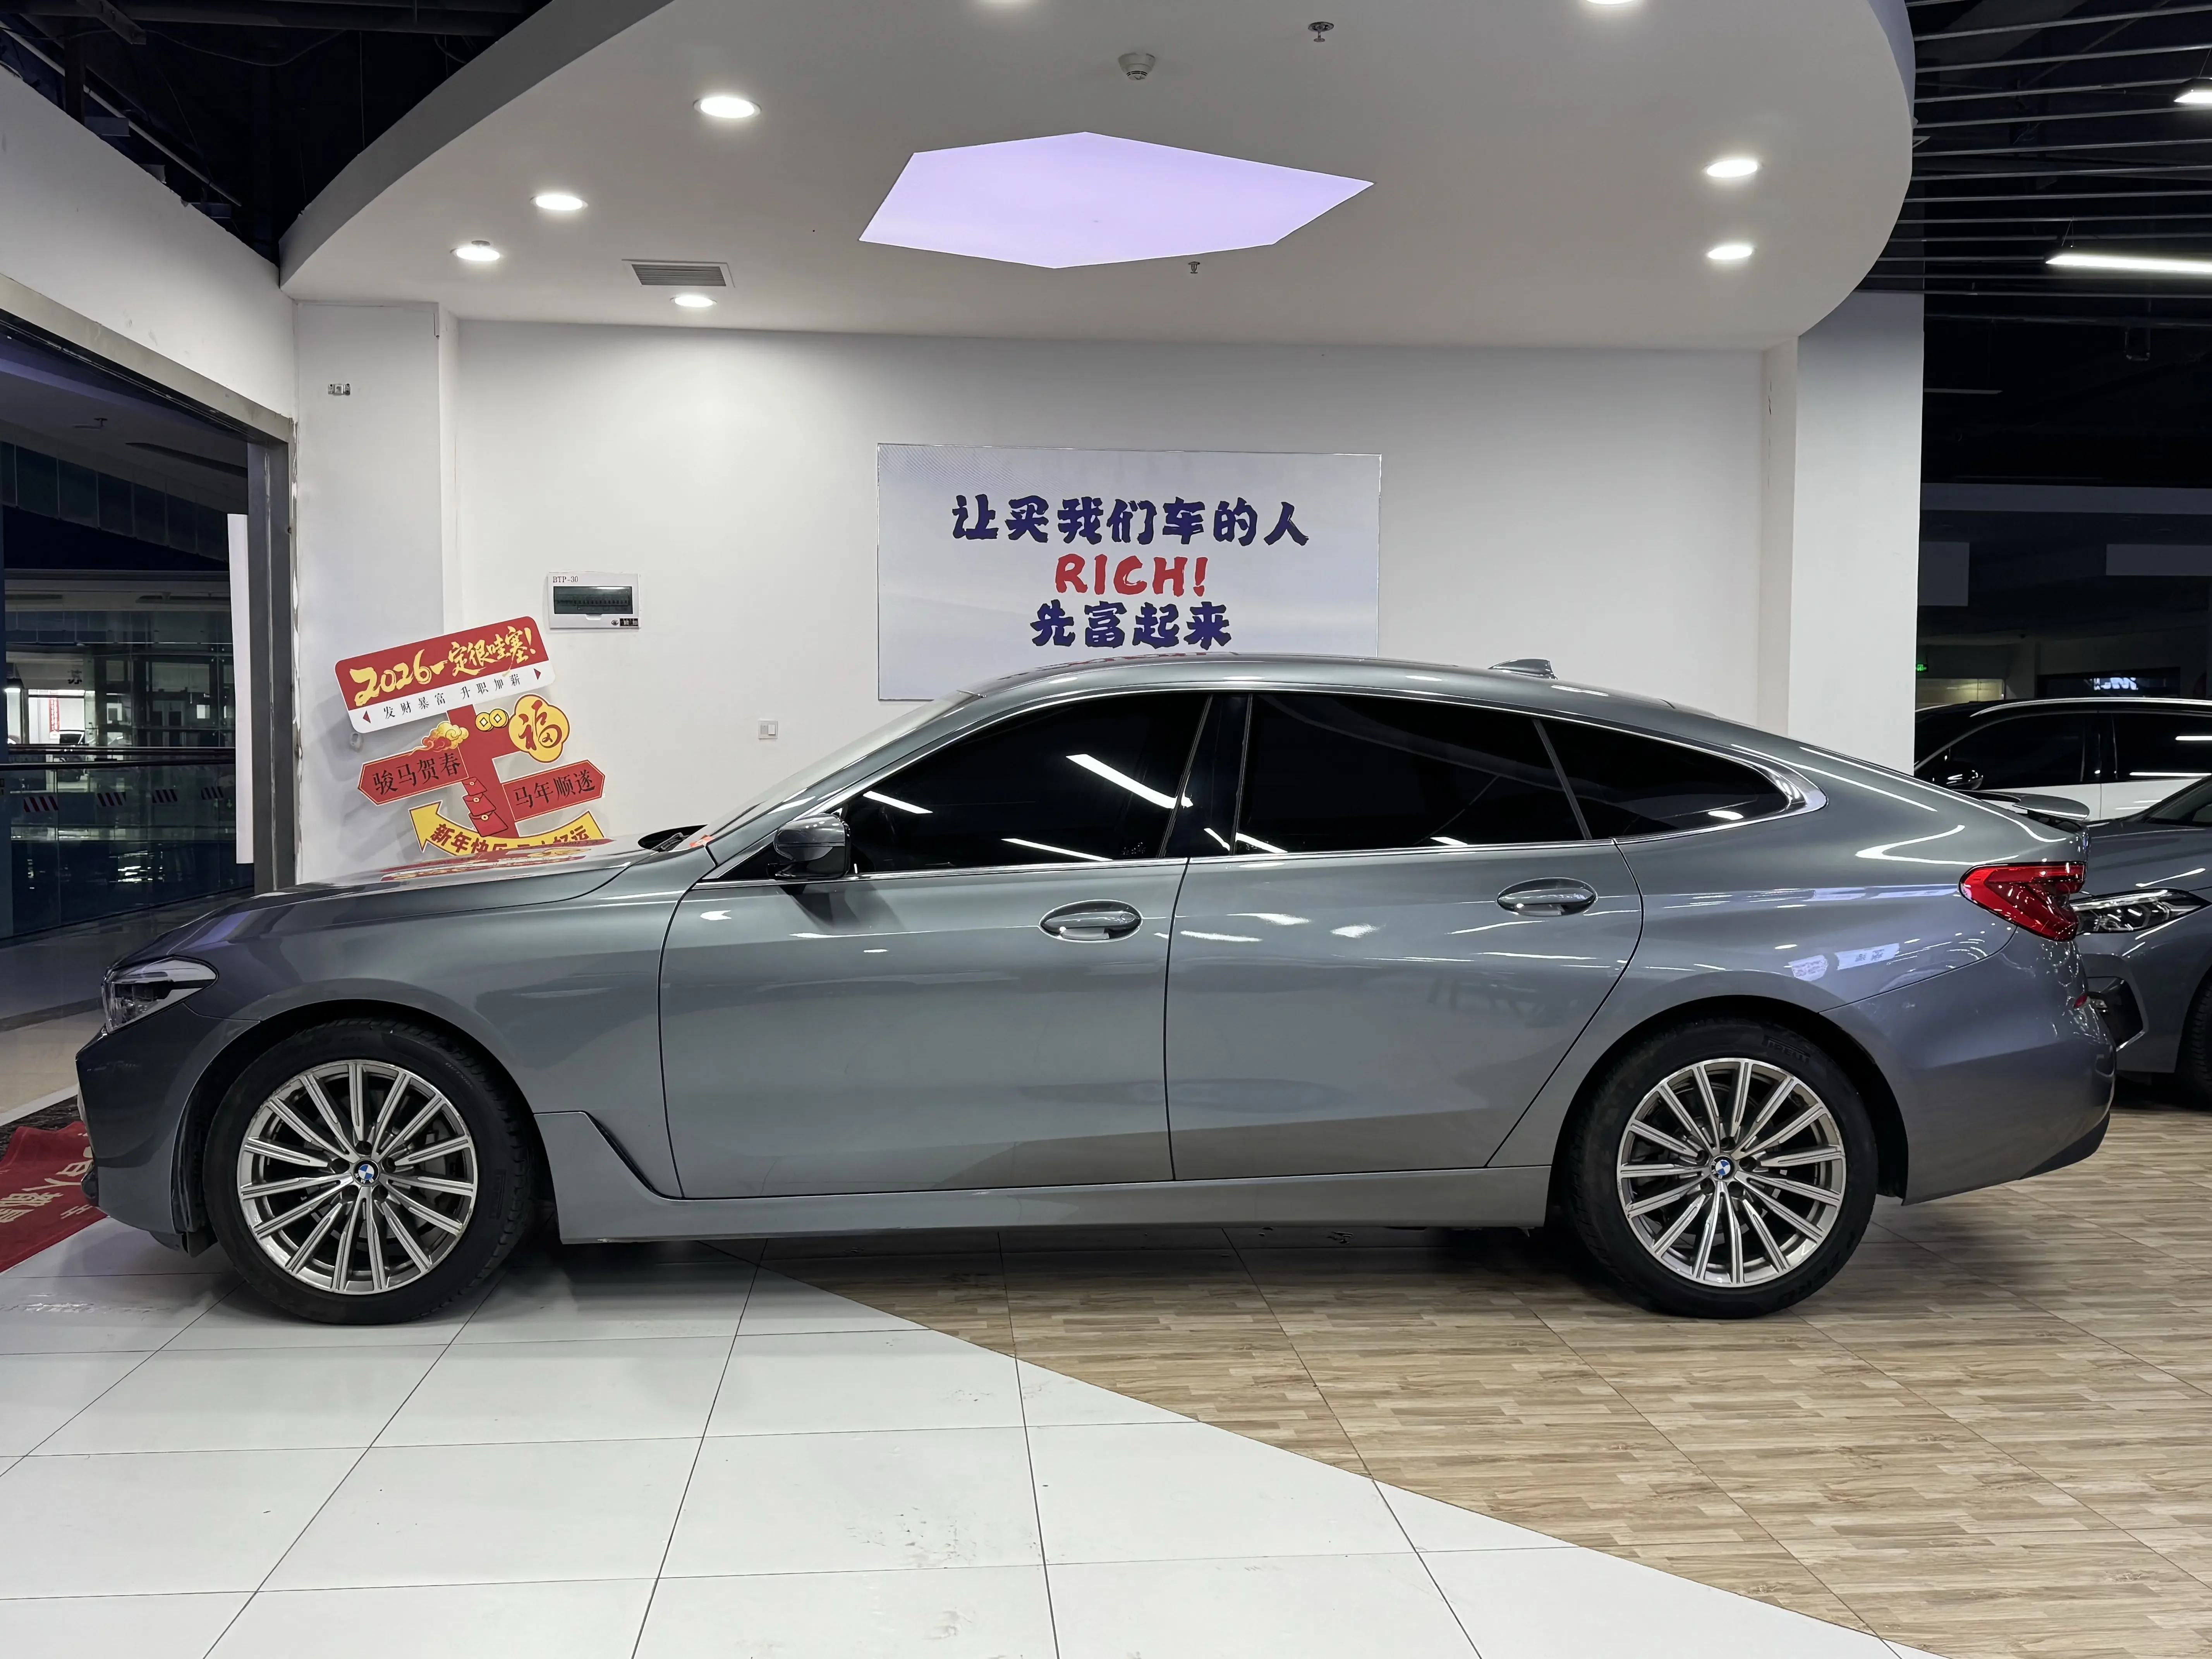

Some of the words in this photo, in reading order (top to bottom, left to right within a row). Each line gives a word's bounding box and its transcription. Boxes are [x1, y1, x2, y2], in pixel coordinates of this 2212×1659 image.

[952, 494, 1309, 546] 让买我们车的人
[1056, 554, 1208, 597] RICH!
[1030, 600, 1231, 650] 先富起来
[383, 692, 447, 719] 发财暴富
[460, 674, 520, 699] 升职加薪
[519, 700, 562, 749] 福
[373, 752, 461, 795] 骏马贺春
[514, 769, 596, 809] 马年顺遂
